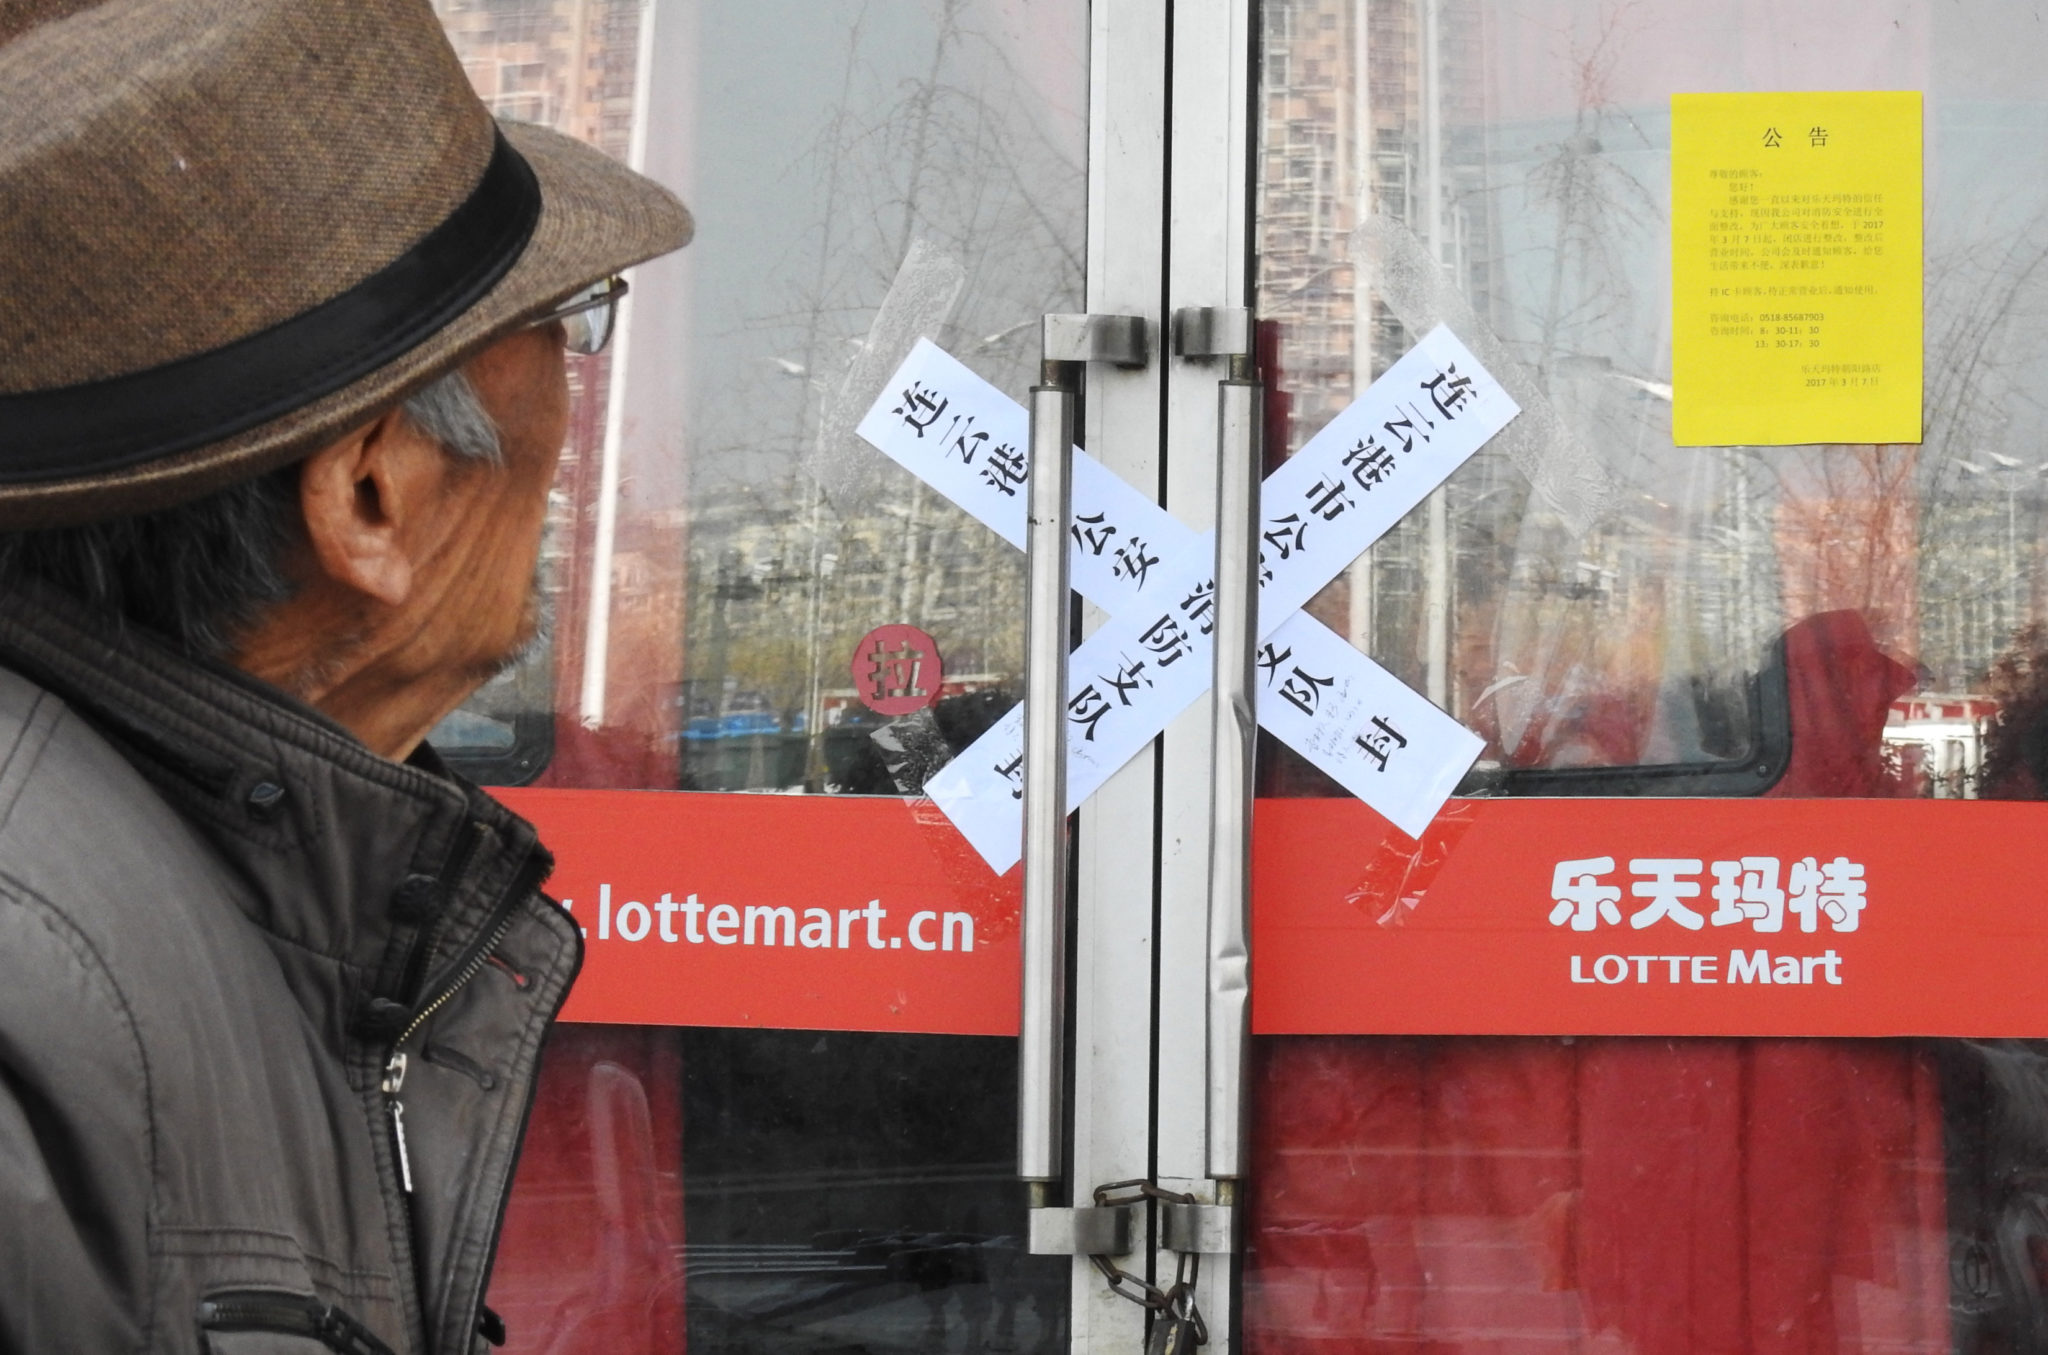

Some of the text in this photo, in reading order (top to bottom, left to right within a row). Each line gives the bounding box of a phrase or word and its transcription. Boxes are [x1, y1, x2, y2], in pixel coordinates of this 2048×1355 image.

[1762, 126, 1829, 148] 公告
[867, 640, 927, 700] 拉
[561, 884, 975, 952] .lottemart.cn
[1548, 856, 1868, 933] 乐天玛特
[1570, 949, 1843, 985] LOTTE Mart
